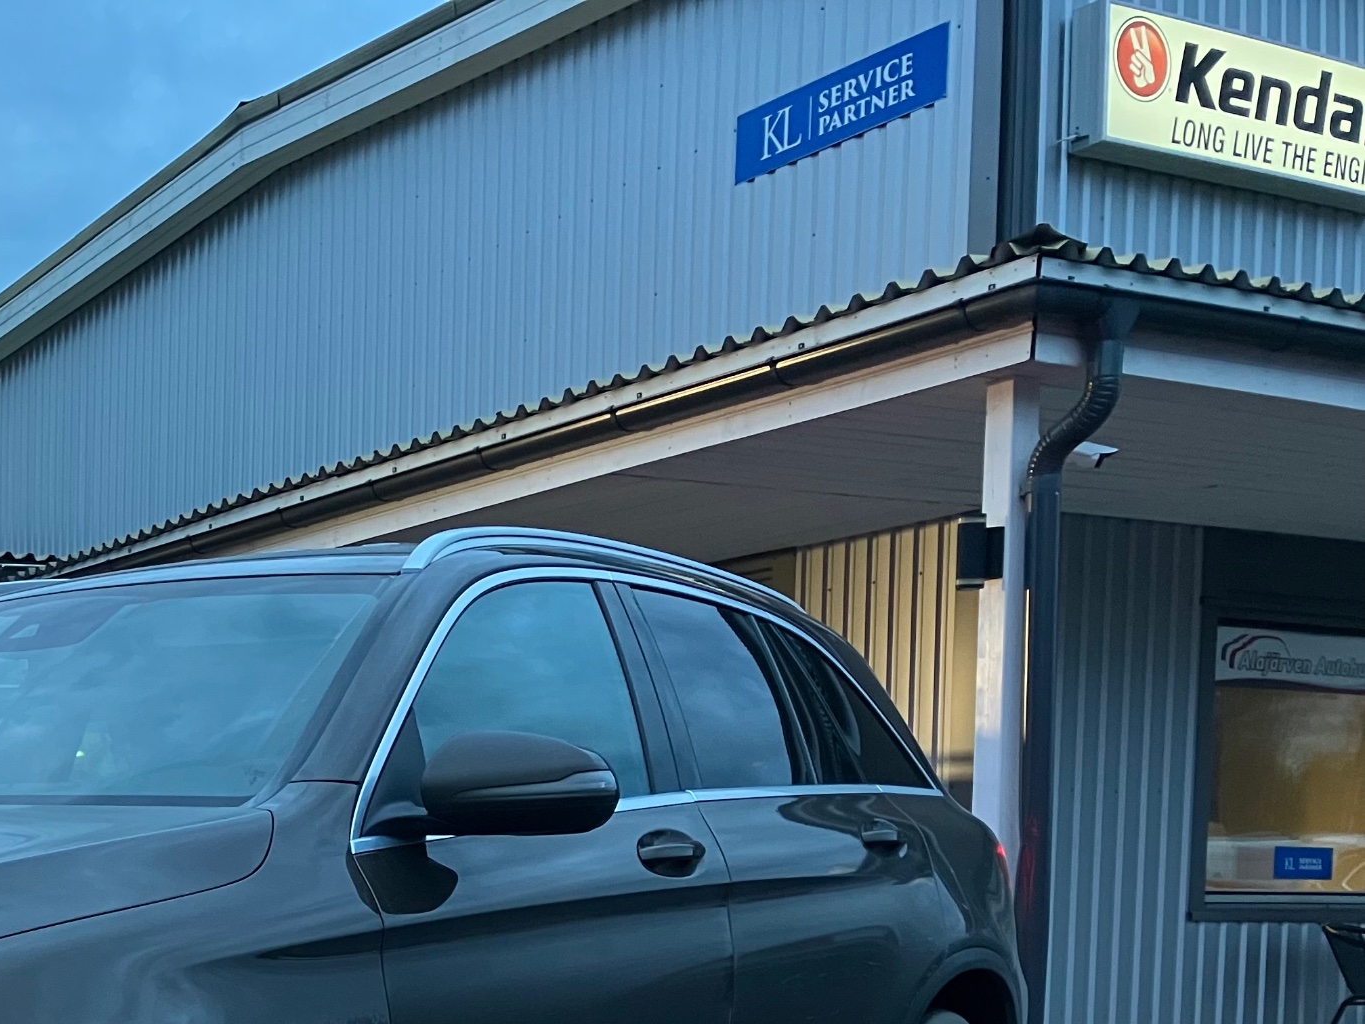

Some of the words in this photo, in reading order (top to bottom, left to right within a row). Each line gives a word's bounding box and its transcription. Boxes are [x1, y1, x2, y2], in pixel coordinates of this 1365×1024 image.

[818, 53, 914, 113] SERVICE
[818, 79, 916, 136] PARTNER
[1175, 42, 1365, 146] Kenda
[760, 105, 802, 161] KL
[1171, 117, 1226, 153] LONG
[1232, 130, 1274, 164] LIVE
[1281, 140, 1318, 174] THE
[1238, 650, 1313, 677] Alajärven
